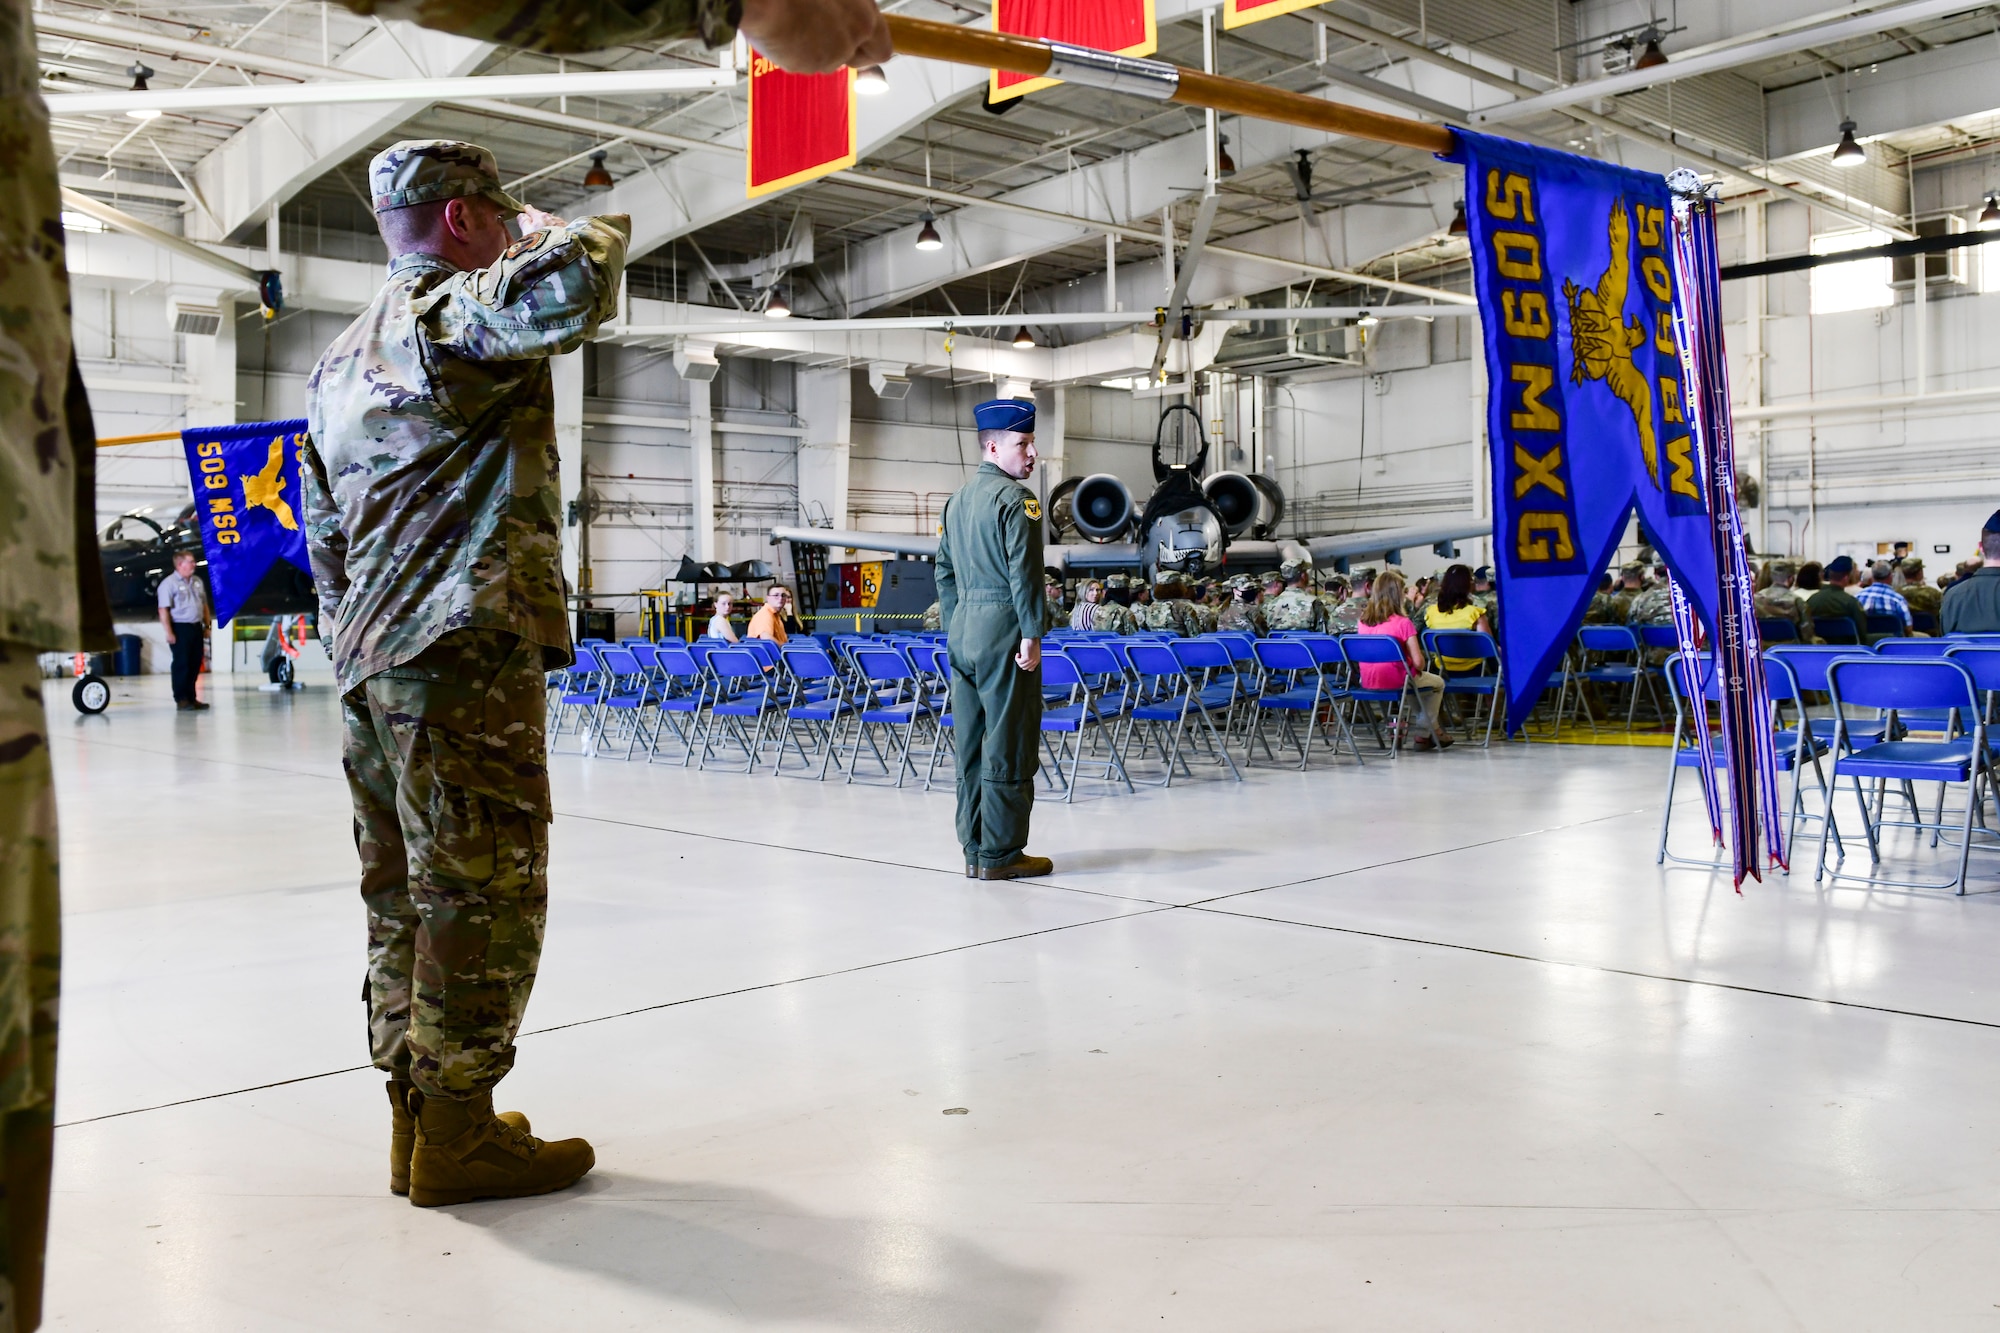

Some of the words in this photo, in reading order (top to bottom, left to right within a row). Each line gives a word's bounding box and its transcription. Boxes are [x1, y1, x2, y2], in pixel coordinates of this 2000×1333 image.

[1486, 168, 1552, 341] 509
[1636, 203, 1676, 357] 509
[1660, 376, 1700, 501] BW
[197, 442, 228, 489] 509
[1511, 362, 1577, 563] MXG
[1714, 455, 1729, 487] JUN
[208, 498, 241, 545] MSG
[1721, 573, 1736, 589] 31
[1723, 614, 1741, 650] MAY
[1729, 676, 1744, 692] 01
